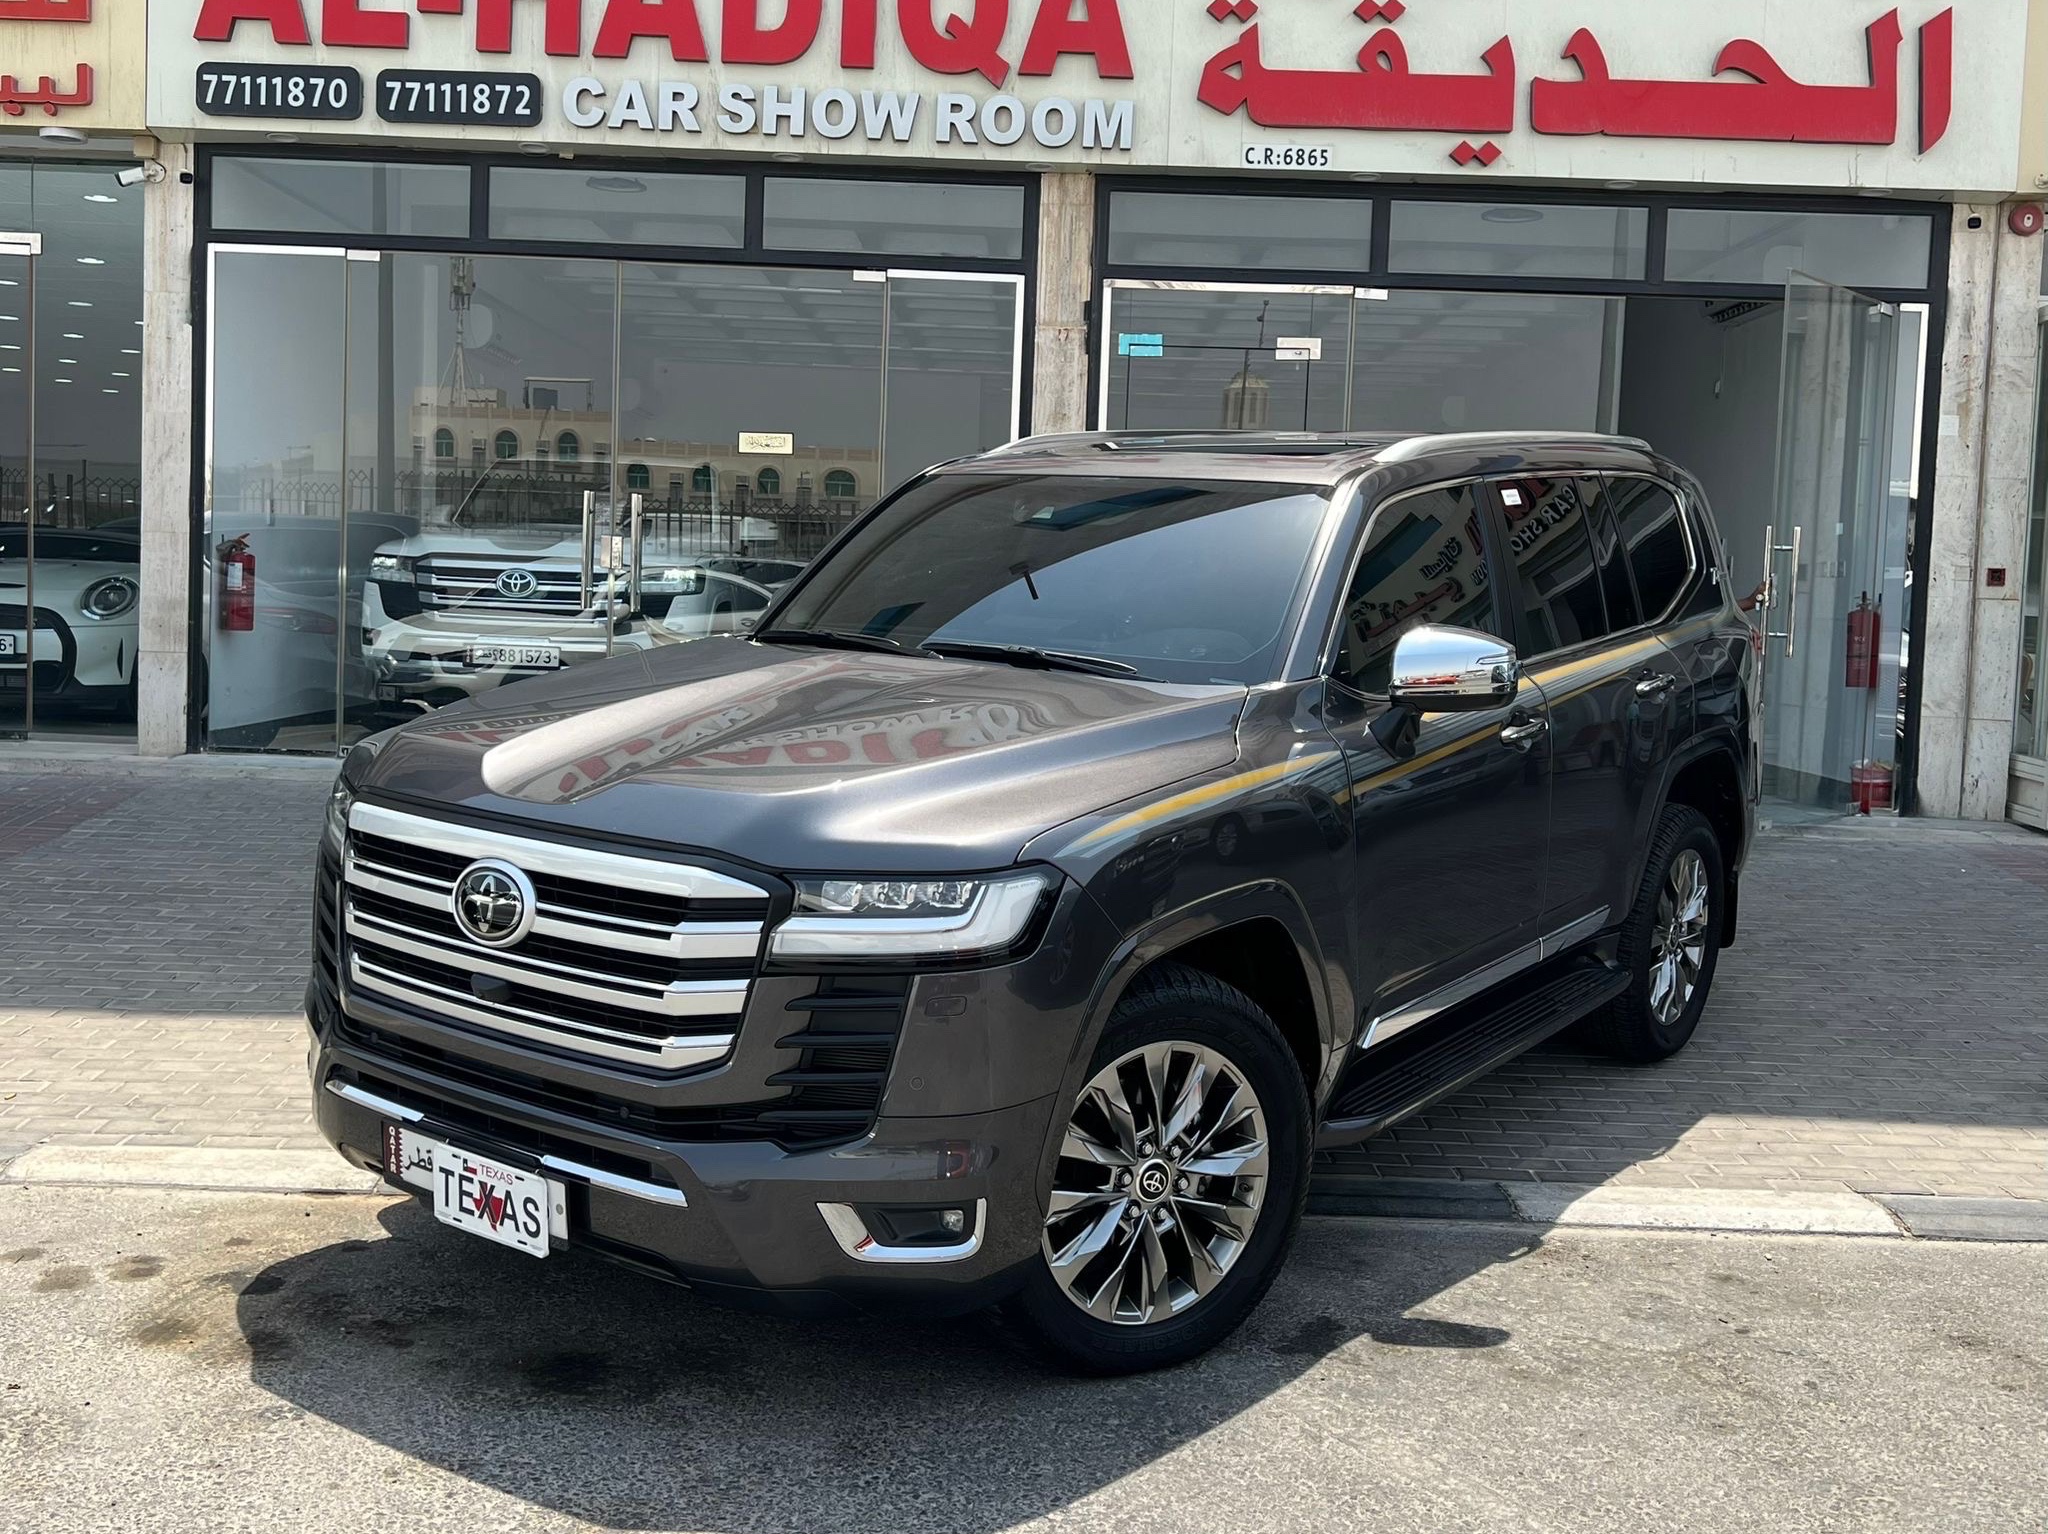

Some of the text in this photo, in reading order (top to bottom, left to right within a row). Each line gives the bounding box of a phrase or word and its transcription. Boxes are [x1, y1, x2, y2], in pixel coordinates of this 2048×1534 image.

[202, 73, 349, 109] 77111870
[385, 81, 532, 116] 77111872
[1196, 0, 1953, 167] الحديقة
[562, 77, 1134, 151] CAR SHOW ROOM
[388, 1125, 397, 1174] QATAR
[404, 1146, 433, 1172] قطر
[479, 1163, 514, 1186] TEXAS
[439, 1166, 541, 1239] TEXAS
